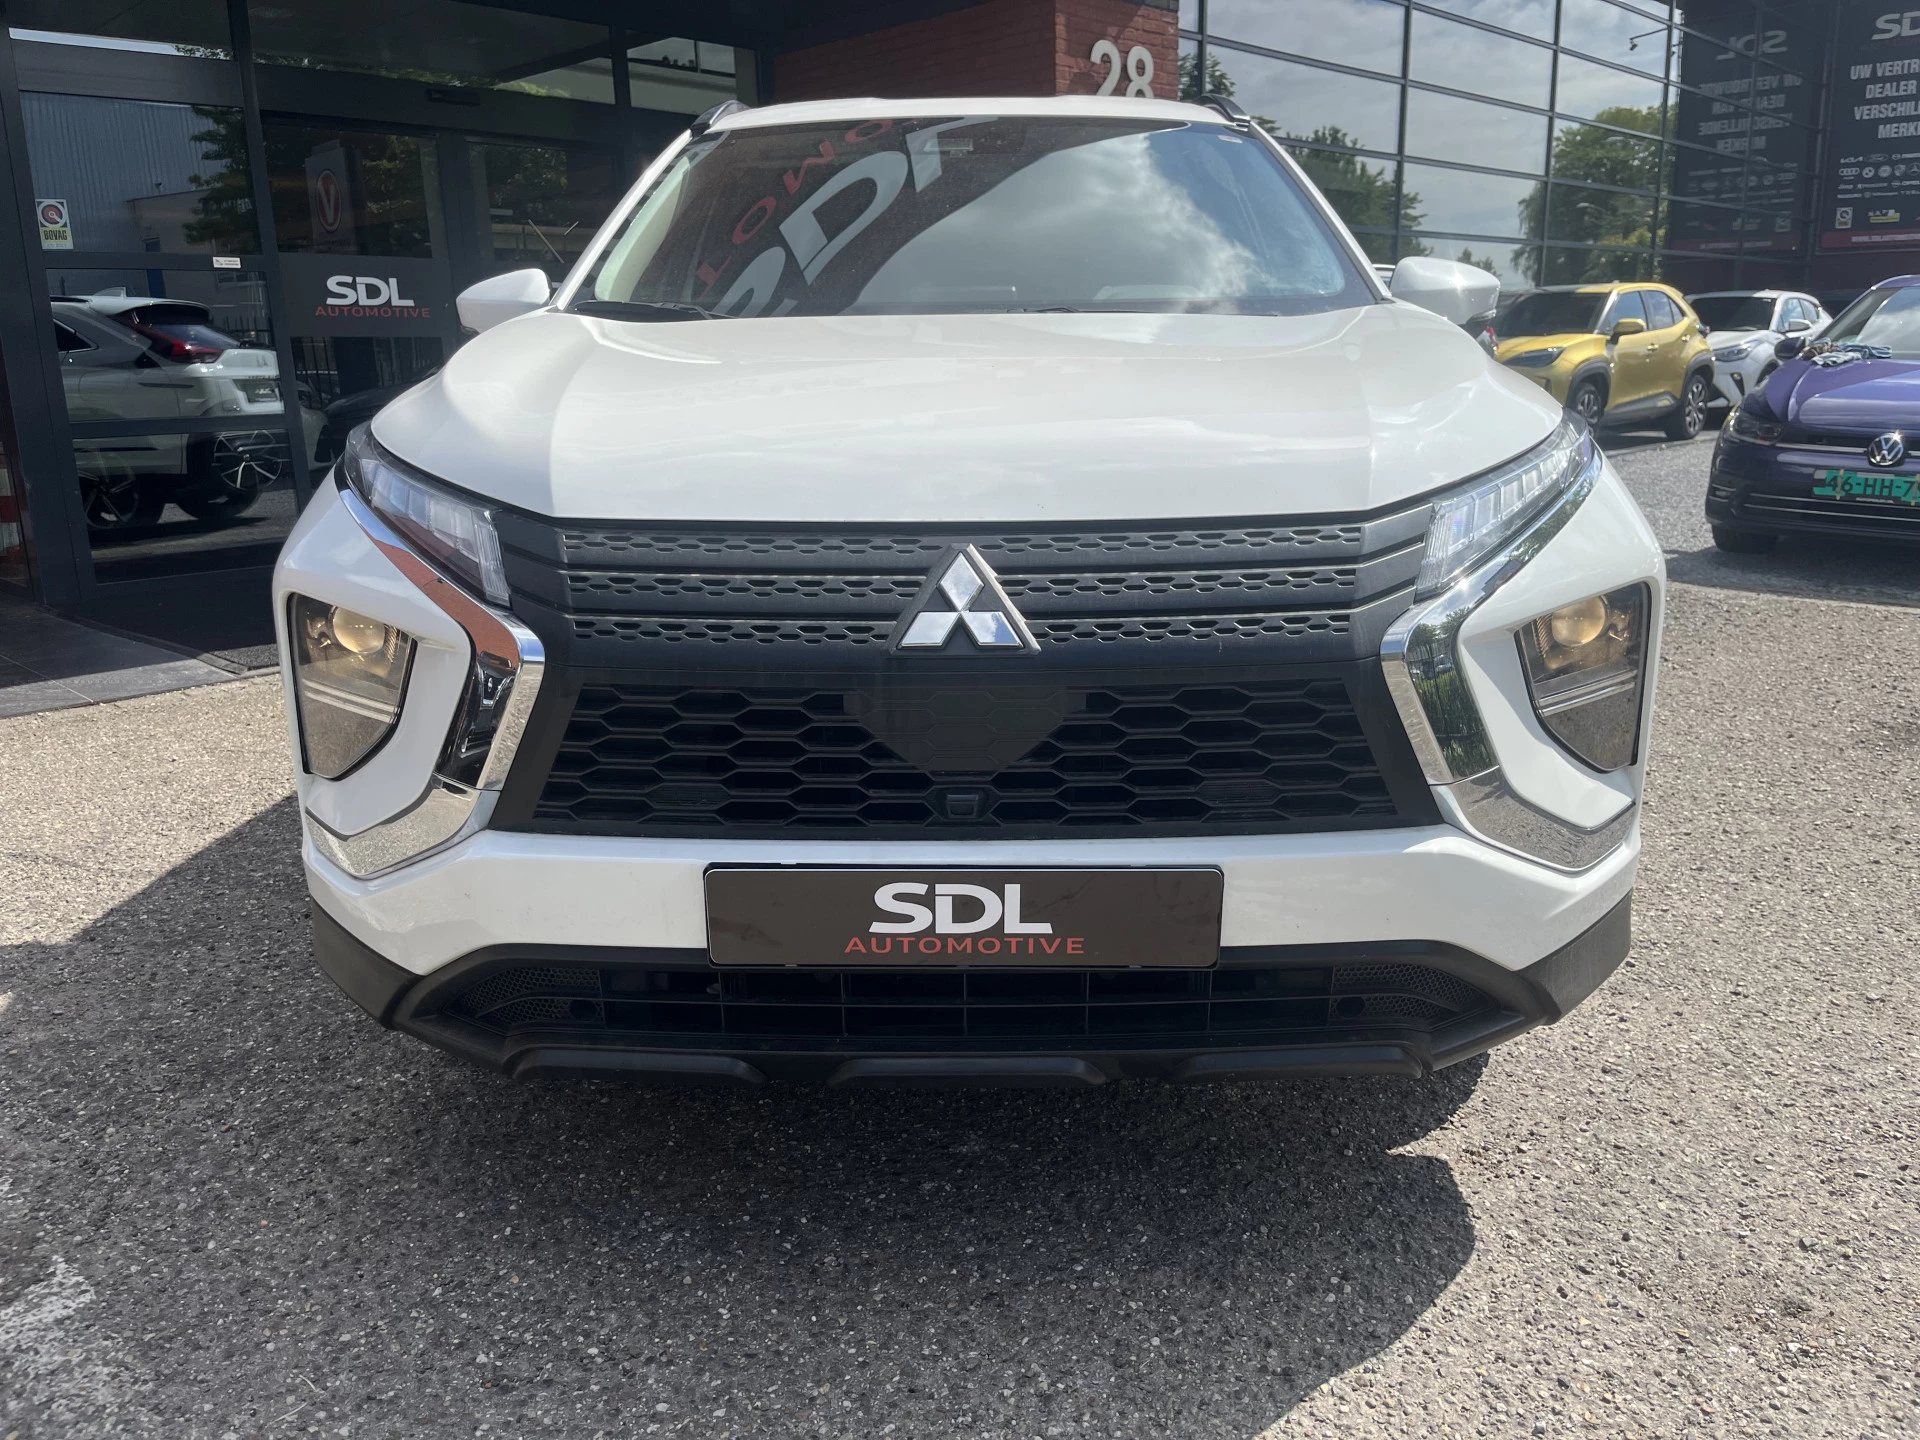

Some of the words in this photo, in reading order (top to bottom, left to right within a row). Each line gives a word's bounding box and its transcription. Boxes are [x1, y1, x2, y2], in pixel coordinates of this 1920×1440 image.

[1090, 39, 1154, 98] 28
[1850, 64, 1873, 79] UW
[1865, 80, 1917, 98] DEALER
[43, 229, 68, 241] BOVAG
[326, 275, 415, 307] SDL
[315, 306, 431, 318] AUTOMOTIVE
[868, 882, 1053, 934] SDL
[844, 936, 1085, 955] AUTOMOTIVE
